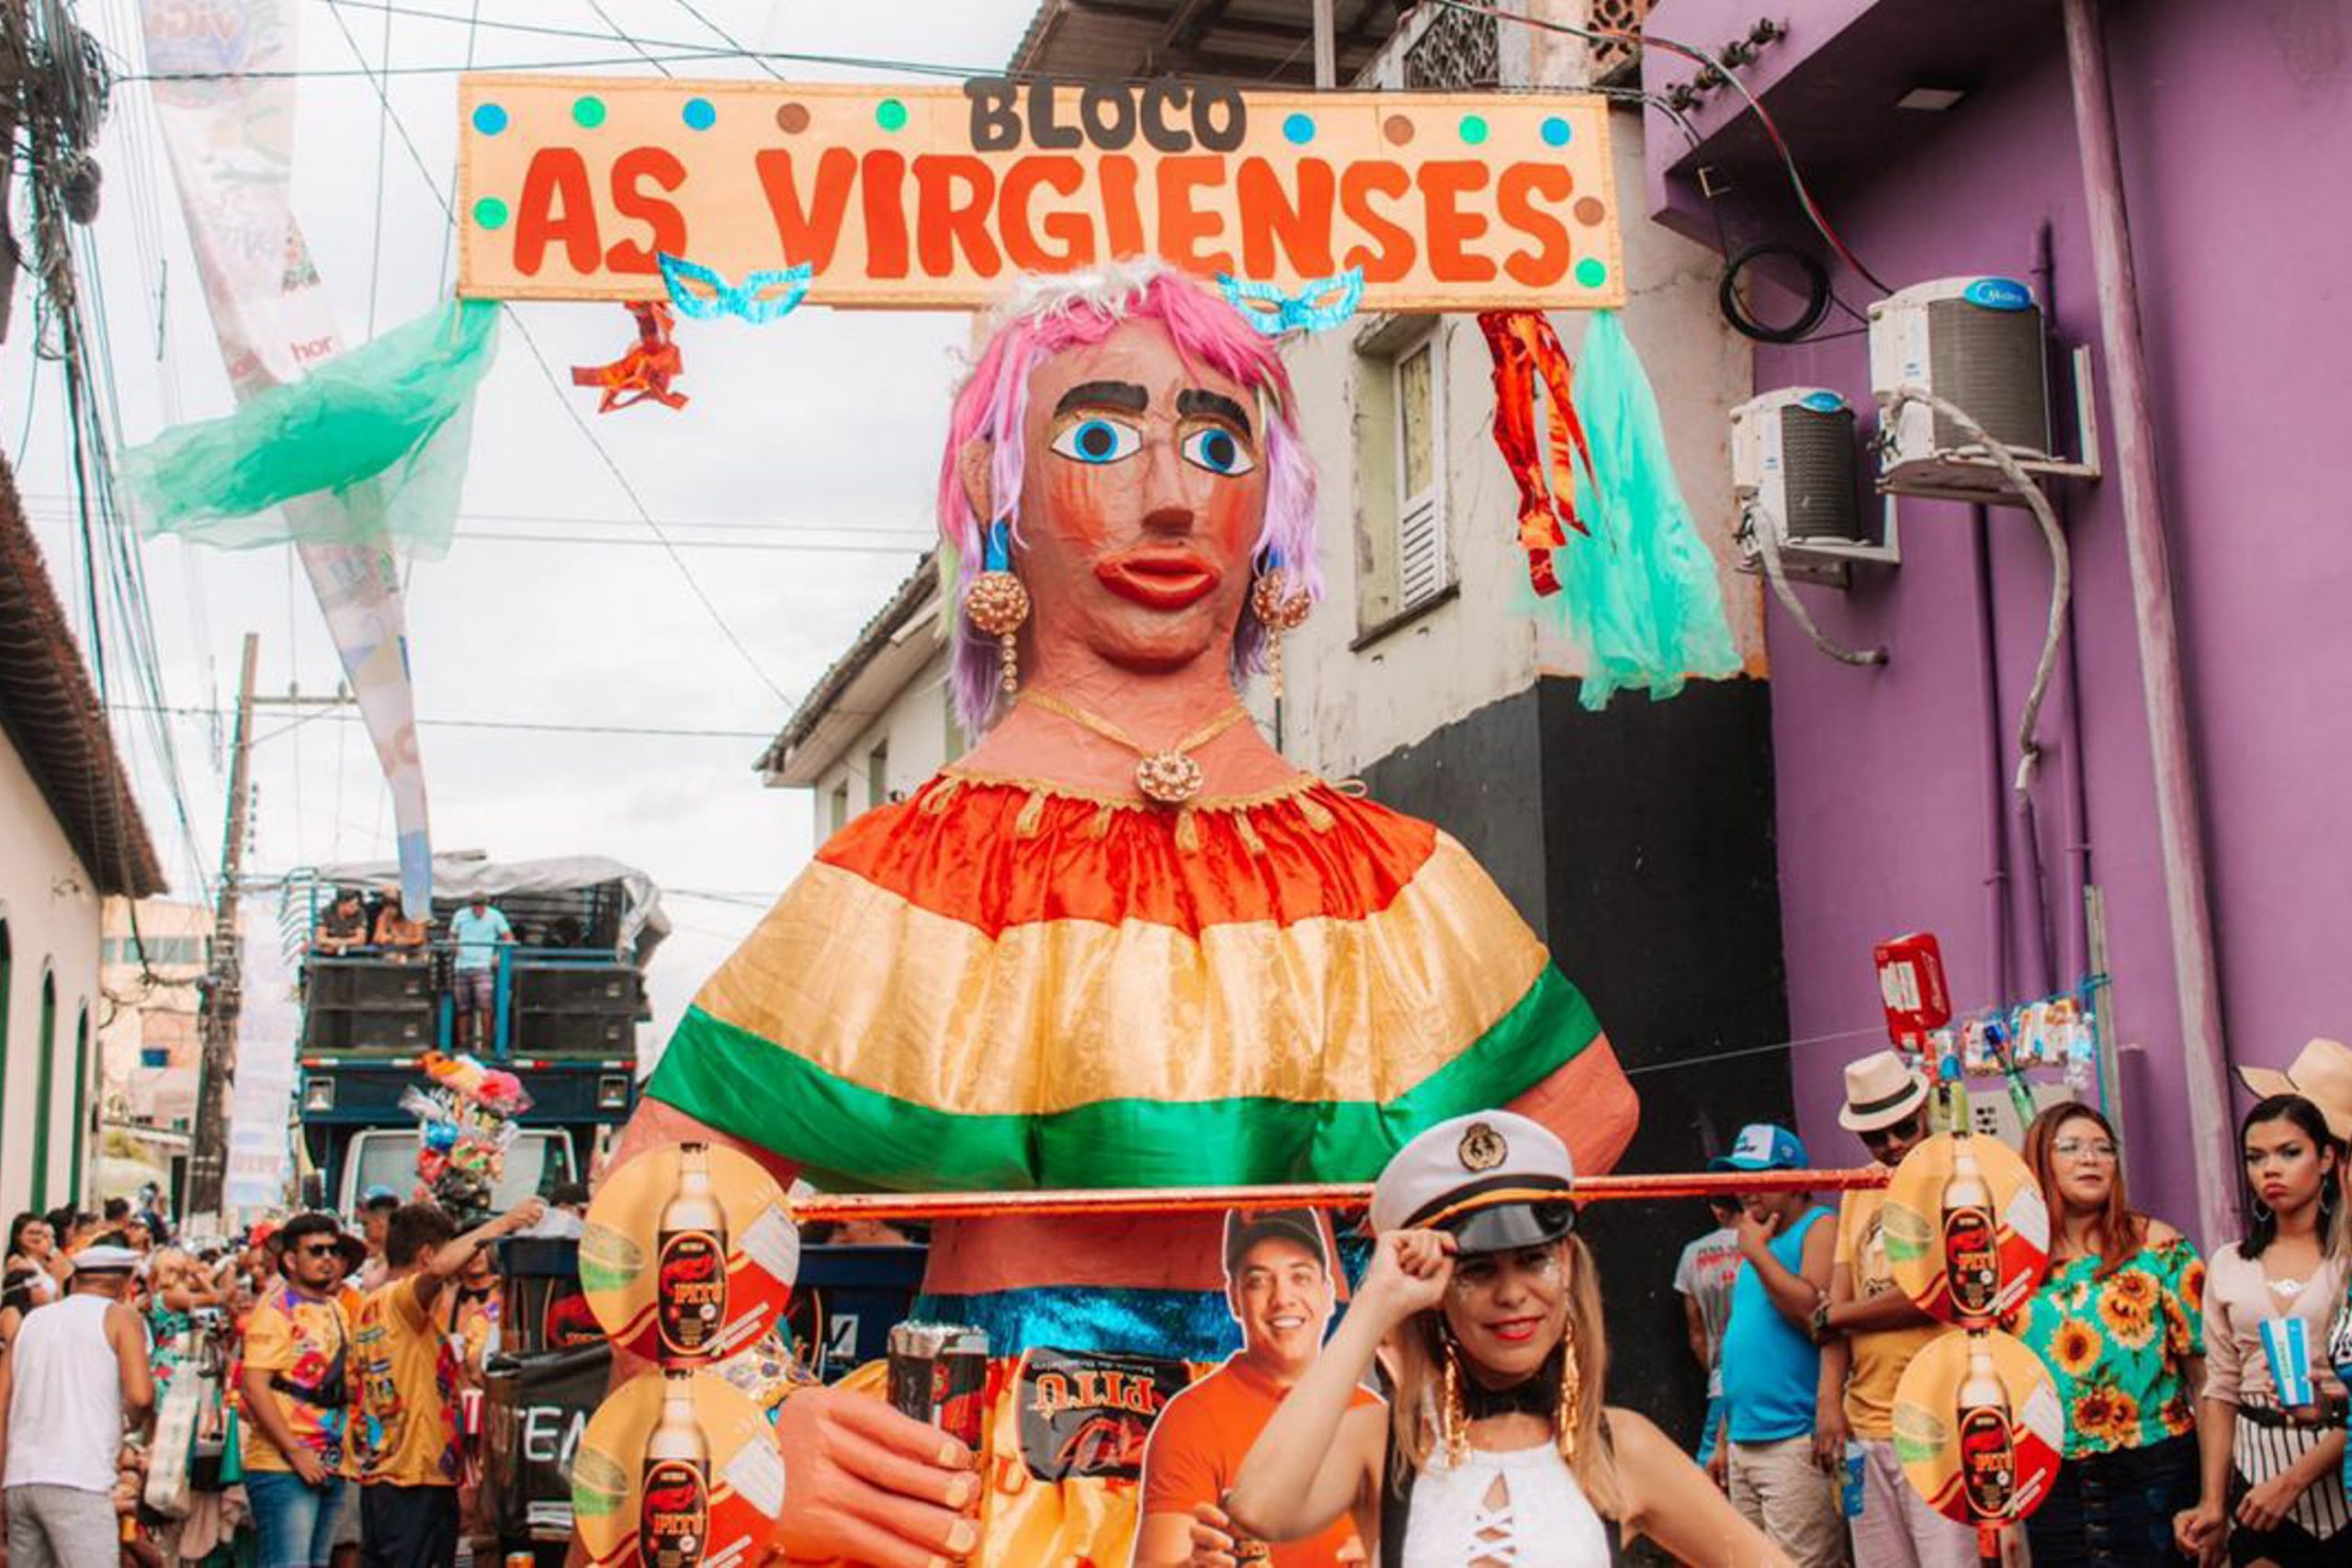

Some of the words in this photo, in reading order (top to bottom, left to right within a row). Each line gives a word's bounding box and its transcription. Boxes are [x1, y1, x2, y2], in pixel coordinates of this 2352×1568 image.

[964, 75, 1247, 152] BLOCO
[513, 146, 688, 276] AS
[755, 147, 1574, 288] VIRGIENSES
